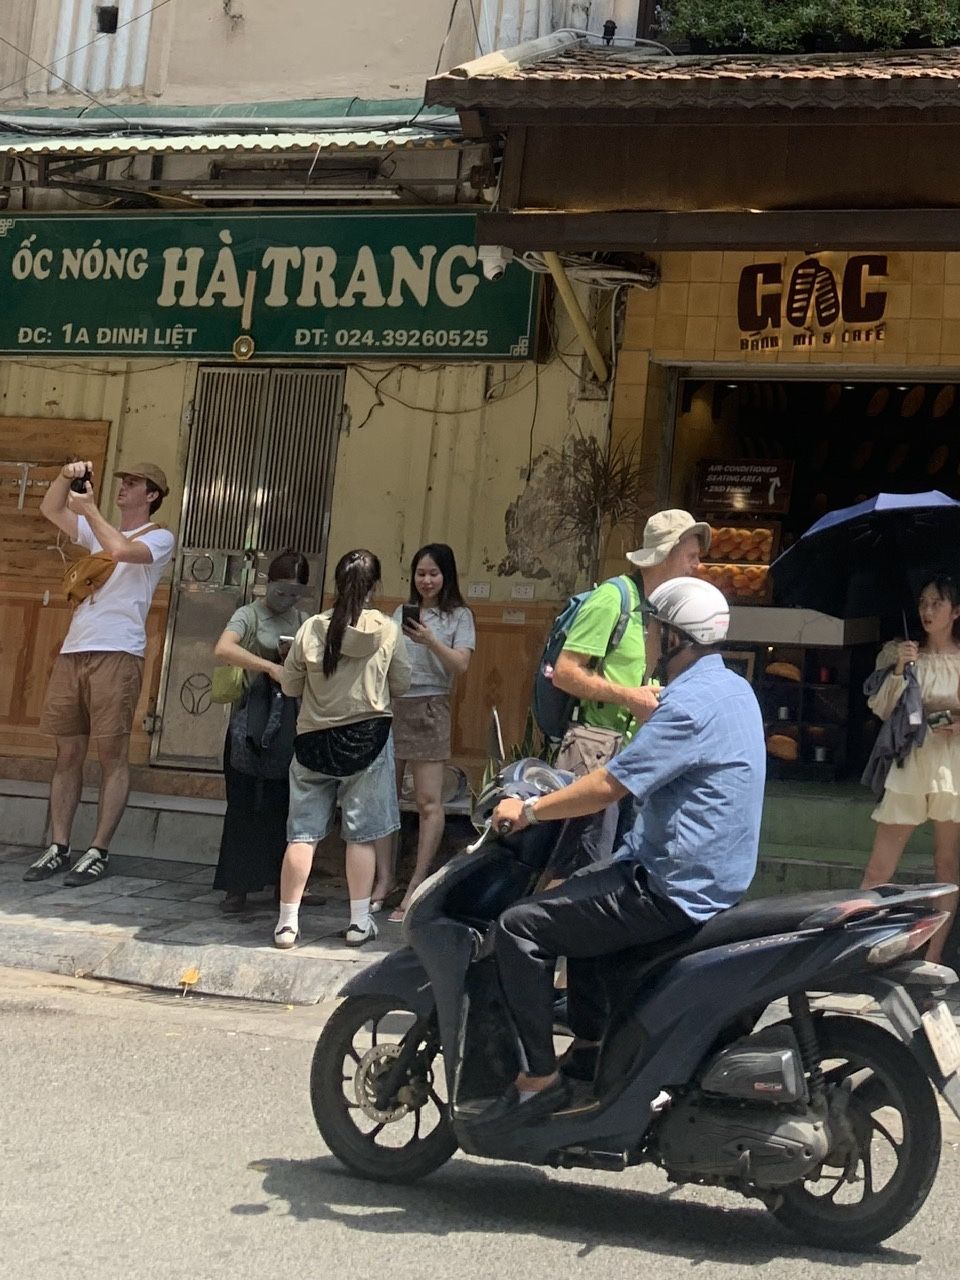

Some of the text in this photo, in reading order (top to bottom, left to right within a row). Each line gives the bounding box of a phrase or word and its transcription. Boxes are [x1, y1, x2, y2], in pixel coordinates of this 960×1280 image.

[12, 229, 480, 308] ỐC NÓNG HÀ TRANG
[18, 323, 197, 349] ĐC: 1A ĐINH LIỆT
[295, 329, 488, 347] ĐT: 024.39260525
